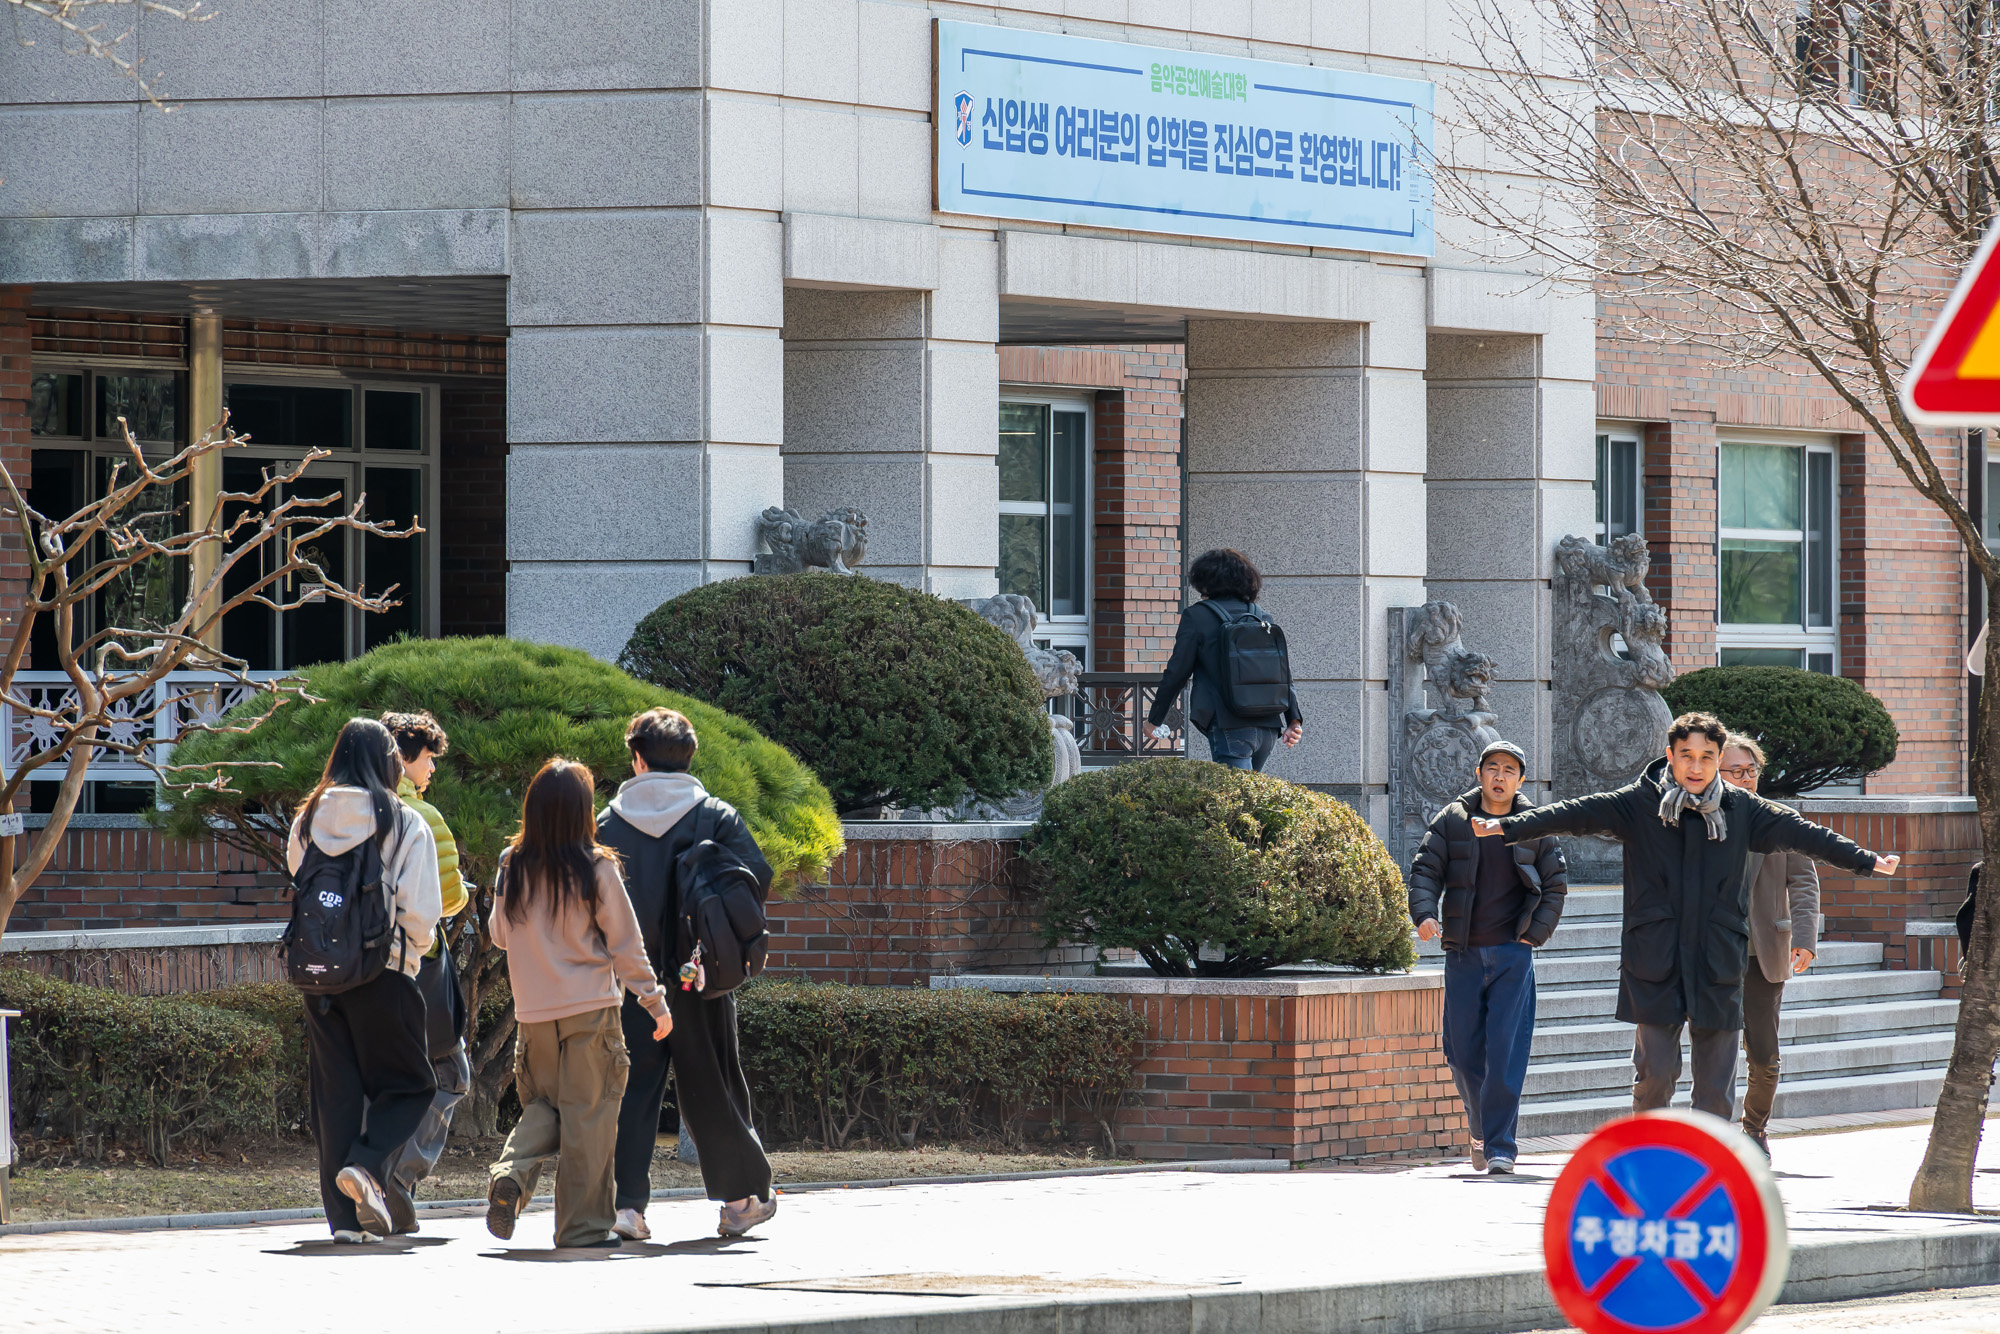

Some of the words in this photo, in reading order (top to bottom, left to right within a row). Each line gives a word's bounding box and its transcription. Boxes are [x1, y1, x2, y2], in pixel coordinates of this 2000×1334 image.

[1150, 62, 1247, 103] 음악공연예술대학
[982, 97, 1049, 156] 신입생
[1055, 105, 1140, 165] 여러분의
[1147, 115, 1208, 172] 입학을
[1214, 123, 1294, 179] 진심으로
[1300, 132, 1400, 191] 환영합니다!
[1574, 1216, 1735, 1261] 주정차금지
